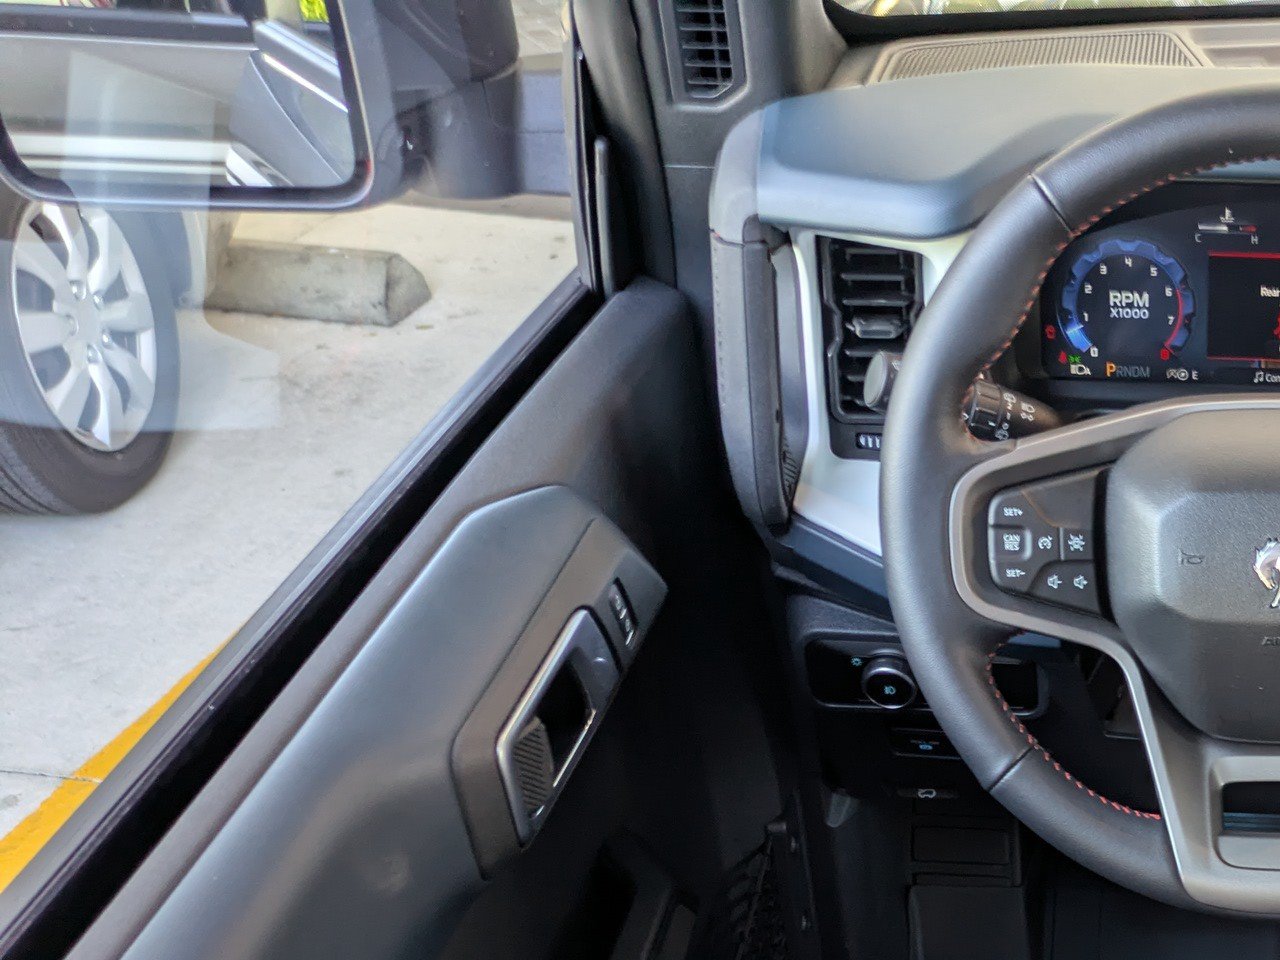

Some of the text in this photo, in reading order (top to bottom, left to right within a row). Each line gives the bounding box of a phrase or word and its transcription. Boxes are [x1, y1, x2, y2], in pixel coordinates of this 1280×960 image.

[1251, 235, 1259, 245] H
[1125, 256, 1133, 267] 4
[1100, 264, 1107, 275] 3
[1150, 266, 1158, 277] 5
[1084, 284, 1092, 294] 2
[1165, 287, 1173, 297] 6
[1260, 285, 1280, 298] Rear
[1109, 290, 1150, 308] RPM
[1083, 313, 1089, 322] 1
[1110, 307, 1149, 319] X1000
[1168, 316, 1175, 325] 7
[1090, 346, 1099, 357] 0
[1003, 507, 1023, 517] SET+
[1003, 534, 1020, 542] CAN
